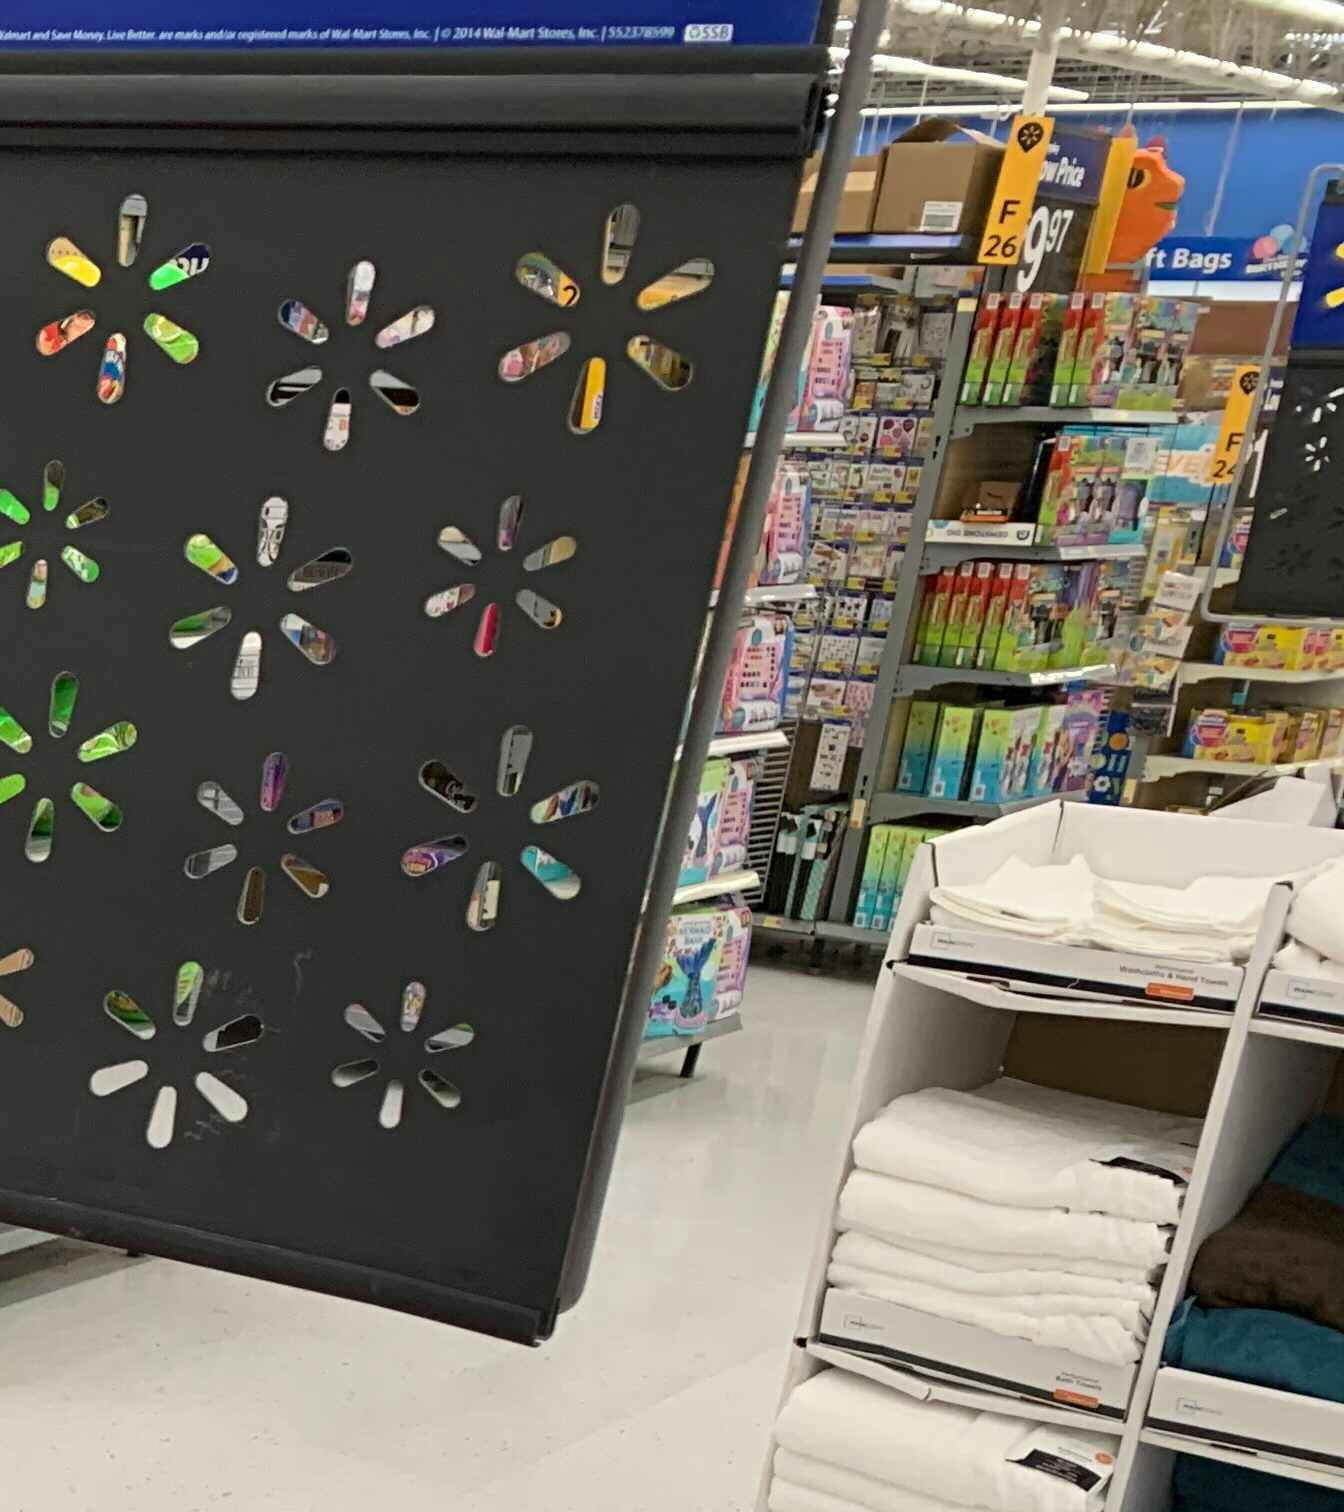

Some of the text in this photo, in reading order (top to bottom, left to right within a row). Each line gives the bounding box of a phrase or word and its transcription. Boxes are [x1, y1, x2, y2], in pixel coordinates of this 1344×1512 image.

[33, 29, 50, 41] and
[174, 29, 204, 41] marks
[288, 28, 319, 40] marks
[453, 27, 481, 39] 2014
[998, 199, 1021, 225] F
[984, 235, 1017, 259] 26
[1145, 246, 1169, 269] ft
[1172, 248, 1233, 271] Bags
[1226, 432, 1245, 452] F
